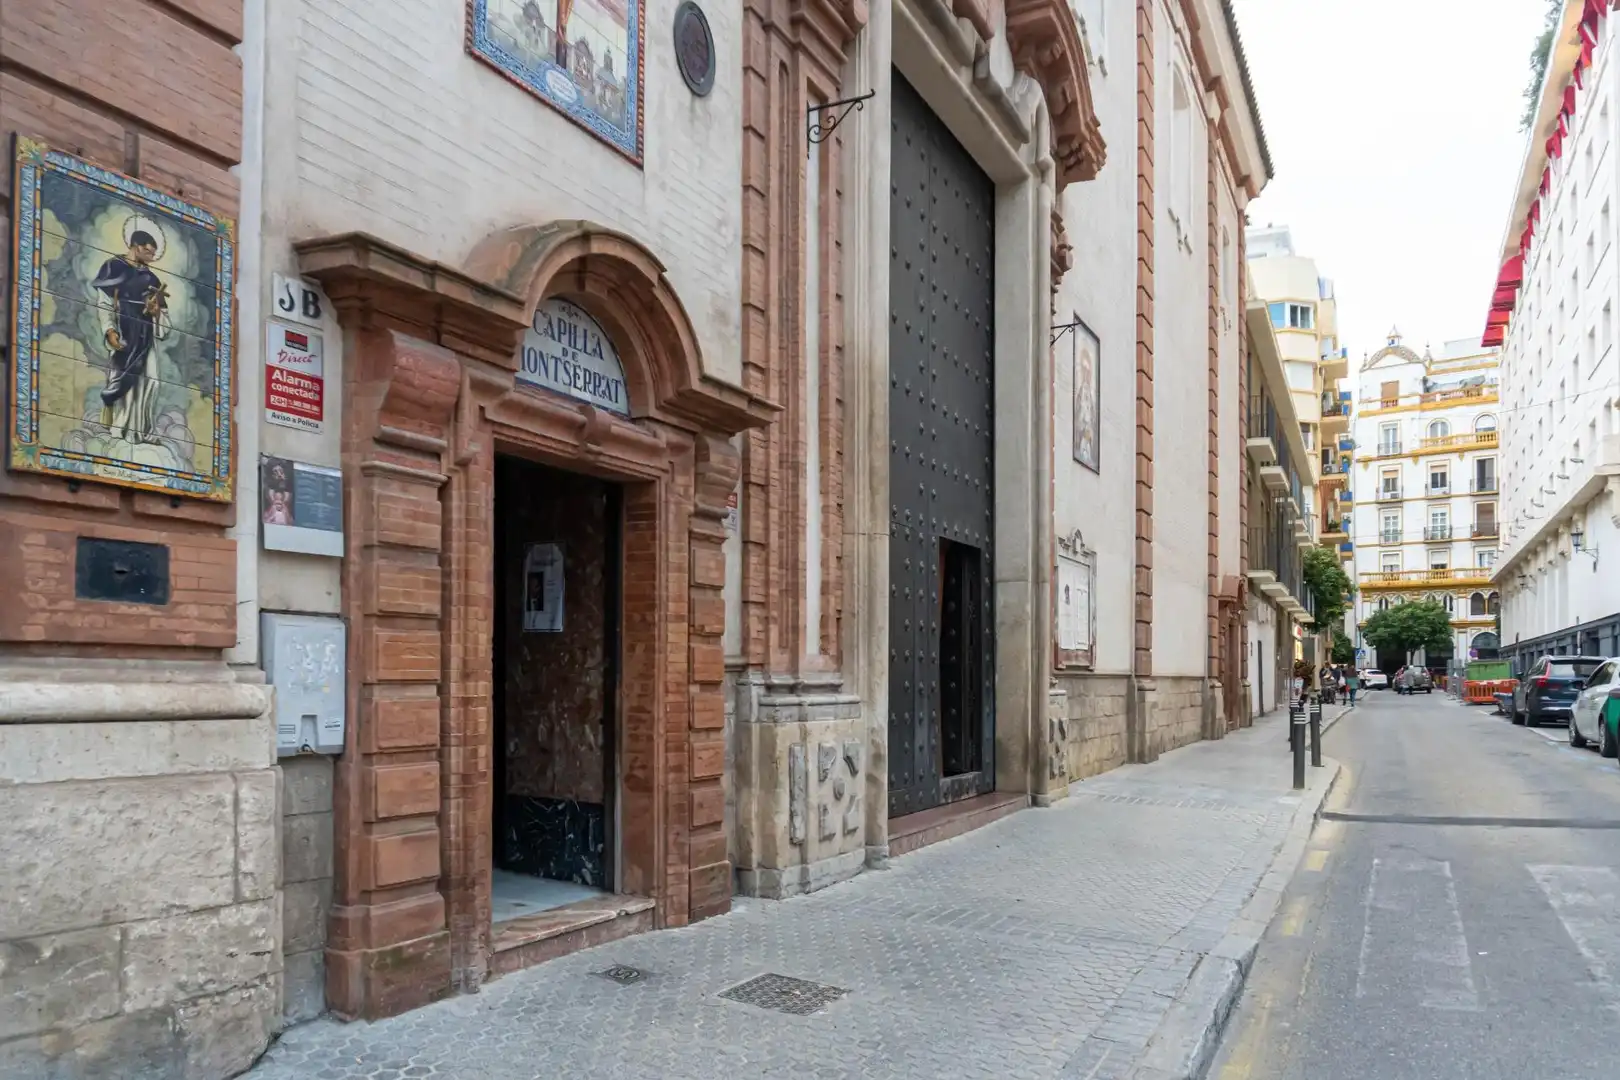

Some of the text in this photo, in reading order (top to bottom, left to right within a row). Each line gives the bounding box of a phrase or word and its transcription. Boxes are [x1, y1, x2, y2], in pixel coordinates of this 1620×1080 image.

[533, 308, 604, 361] CAPILLA
[562, 347, 579, 363] DE
[271, 369, 320, 392] Alarma
[271, 382, 320, 401] conectada
[271, 411, 291, 422] Aviso
